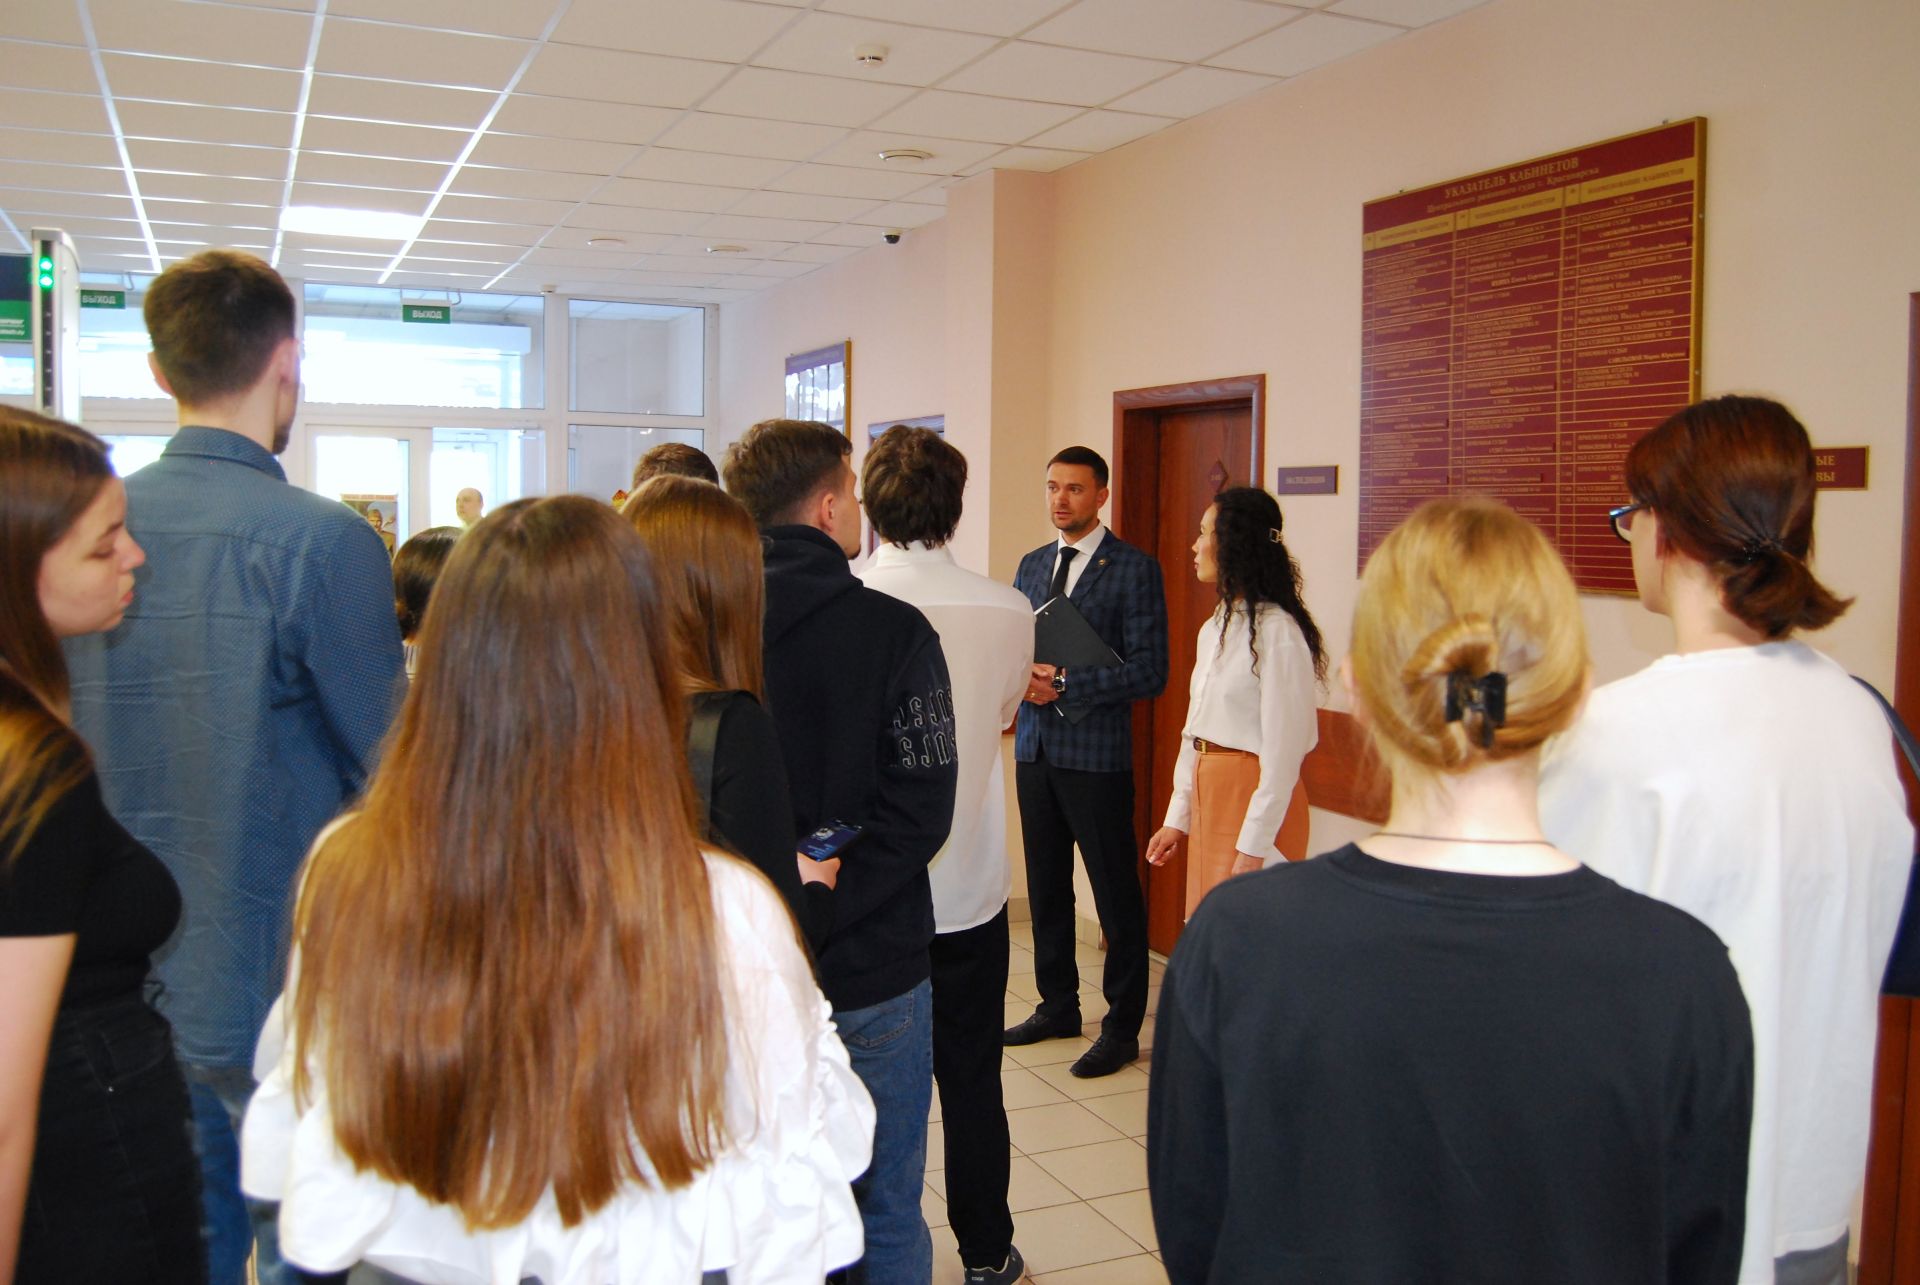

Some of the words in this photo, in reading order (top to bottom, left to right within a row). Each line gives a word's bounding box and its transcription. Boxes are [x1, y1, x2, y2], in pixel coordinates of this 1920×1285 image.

[1445, 176, 1506, 200] УКАЗАТЕЛЬ
[1509, 158, 1579, 184] КАБИНЕТОВ
[82, 295, 116, 304] ВЫХОД
[412, 310, 442, 319] ВЫХОД
[1815, 456, 1836, 466] ЫЕ
[1815, 472, 1836, 482] ВЫ
